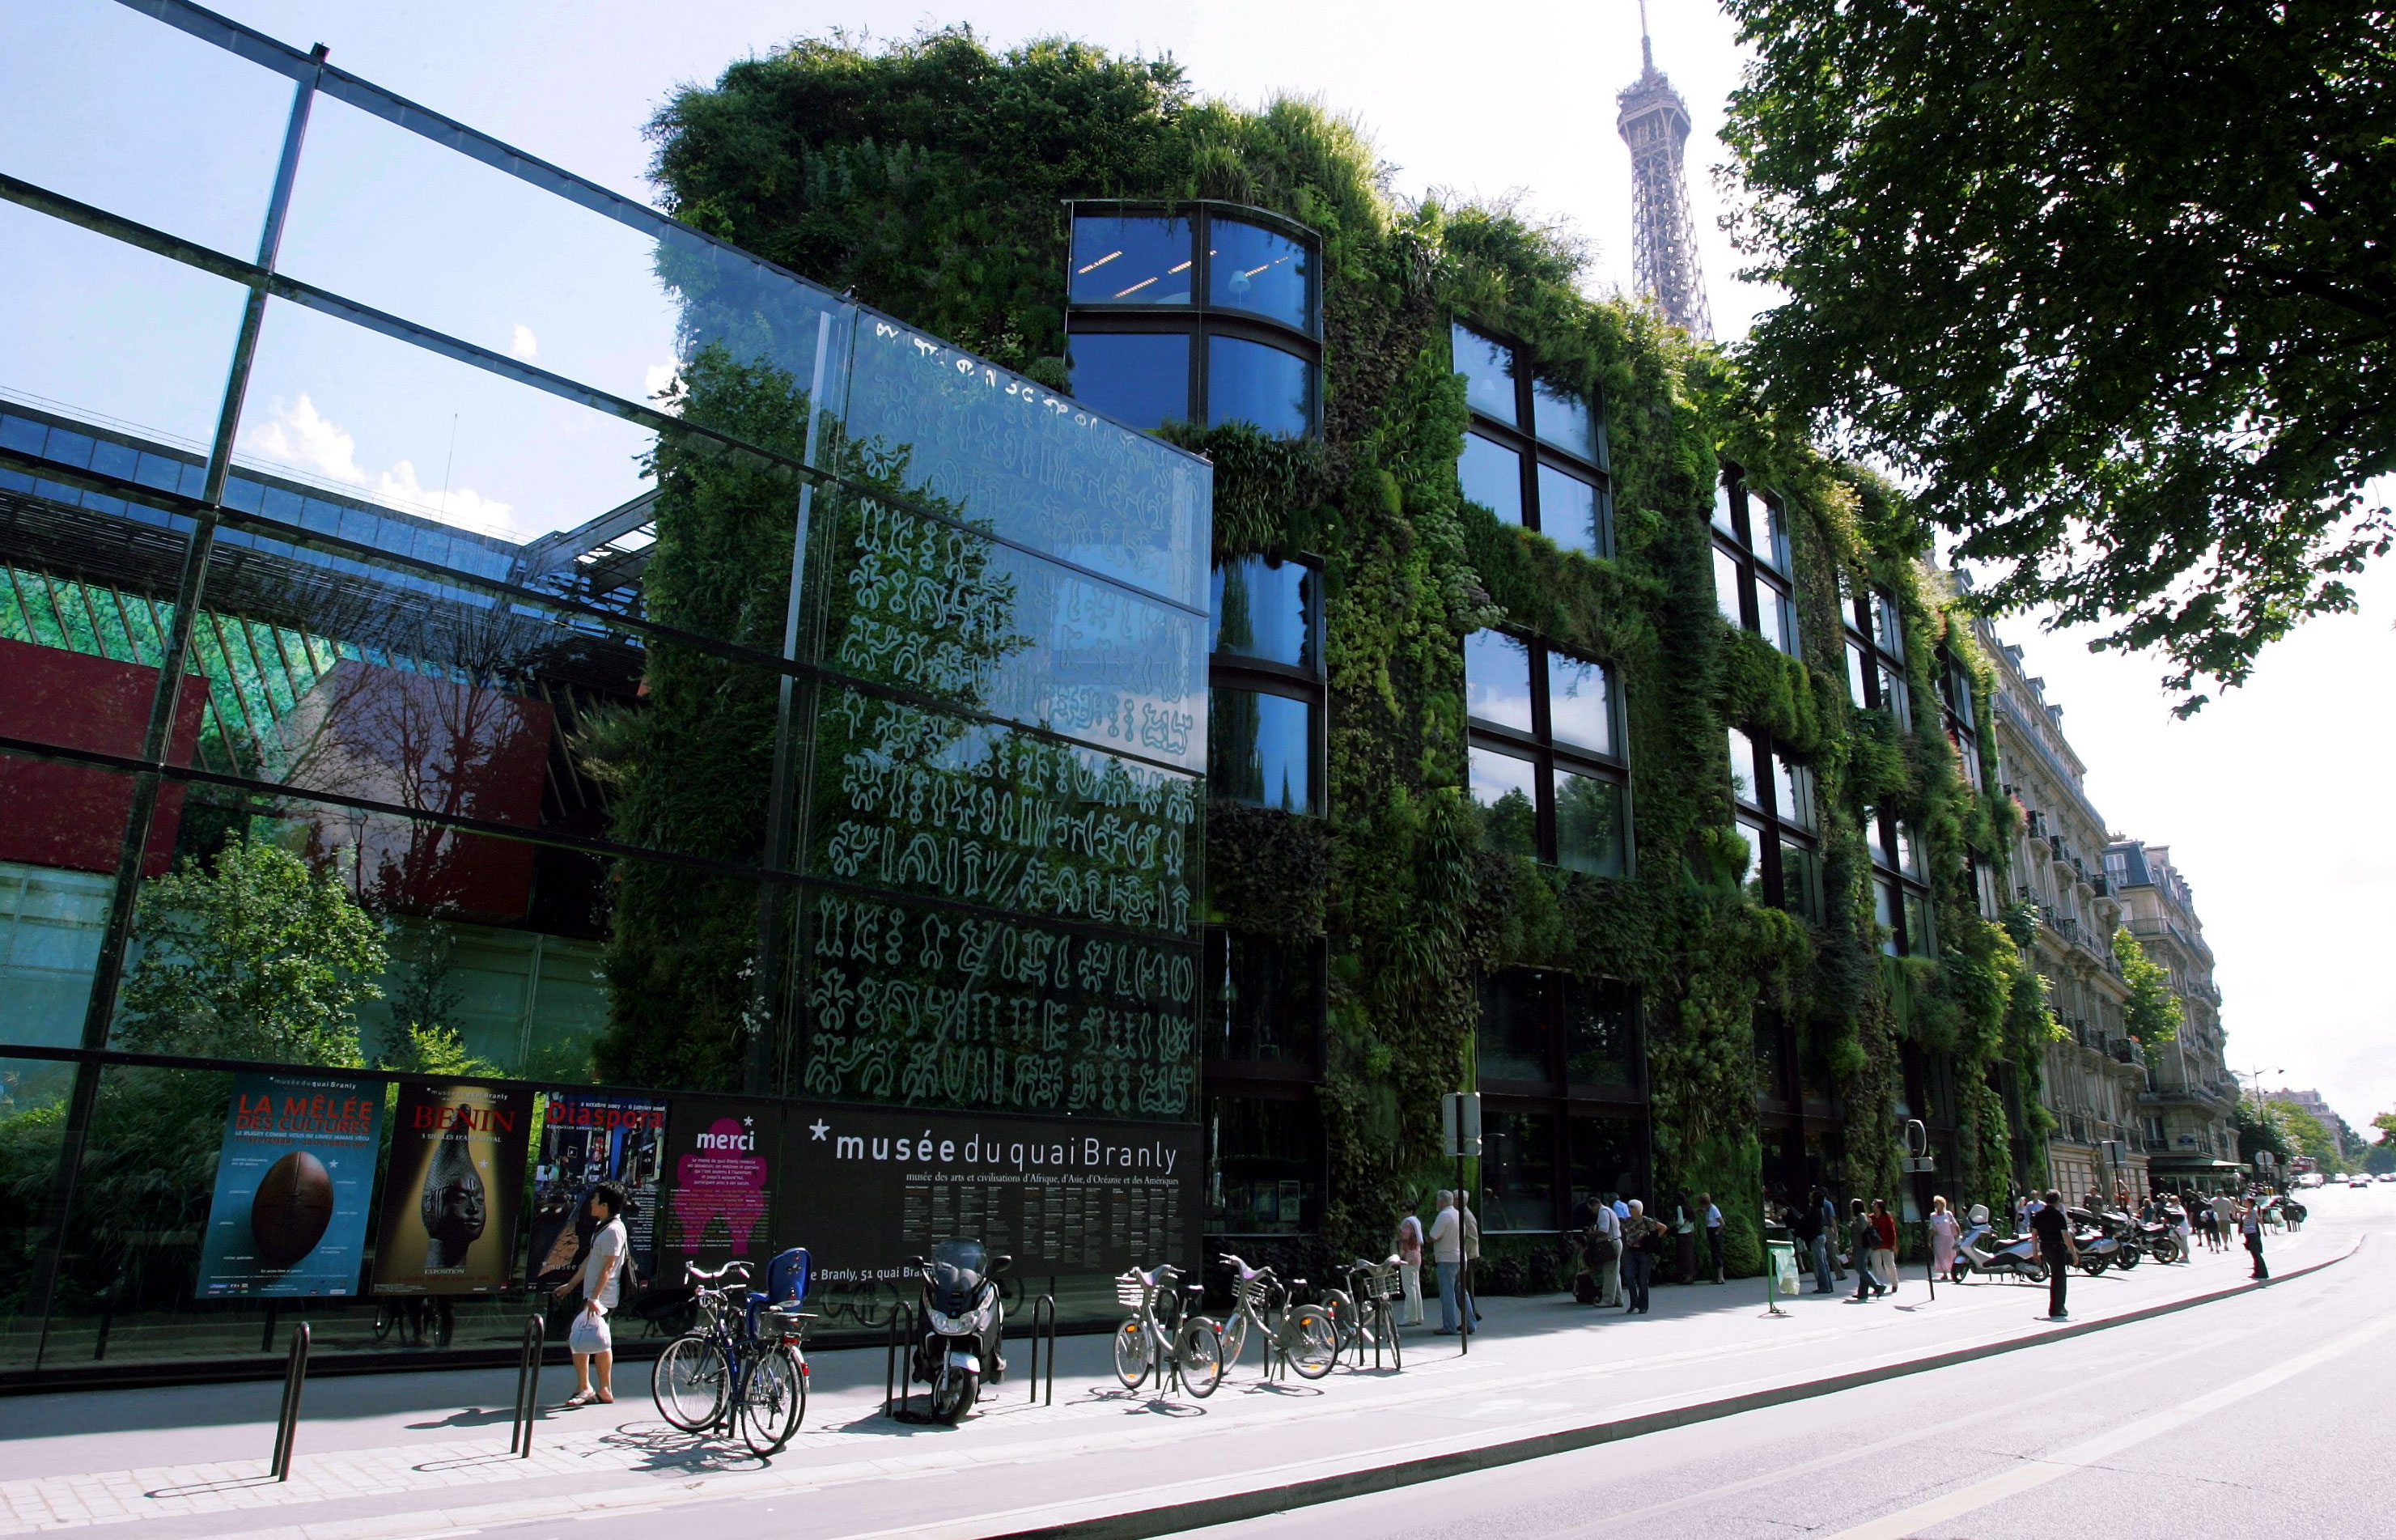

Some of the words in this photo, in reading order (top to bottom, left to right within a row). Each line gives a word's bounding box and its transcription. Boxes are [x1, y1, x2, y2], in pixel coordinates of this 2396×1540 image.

[312, 1080, 329, 1088] quai
[330, 1081, 357, 1090] Branly
[485, 1092, 509, 1101] Branly
[238, 1094, 274, 1115] LA
[284, 1094, 374, 1120] MÊLÉE
[546, 1101, 664, 1131] Diaspora
[235, 1114, 274, 1131] DES
[278, 1116, 372, 1135] CULTURES
[412, 1104, 516, 1132] BENIN
[697, 1131, 754, 1151] merci
[836, 1130, 956, 1162] musée
[965, 1133, 1000, 1163] du
[1010, 1137, 1075, 1172] quai
[1084, 1138, 1177, 1174] Branly
[906, 1172, 932, 1182] musée
[935, 1172, 948, 1182] des
[950, 1172, 965, 1182] arts
[966, 1173, 975, 1182] et
[977, 1172, 1020, 1183] civilisations
[1023, 1173, 1060, 1185] d'Afrique,
[1061, 1174, 1086, 1185] d'Asie,
[1087, 1174, 1122, 1184] d'Océanie
[1123, 1176, 1130, 1185] et
[1132, 1175, 1143, 1185] des
[1144, 1176, 1179, 1187] Amériques
[821, 1268, 858, 1282] Branly,
[861, 1271, 873, 1281] 51
[877, 1266, 899, 1281] quai
